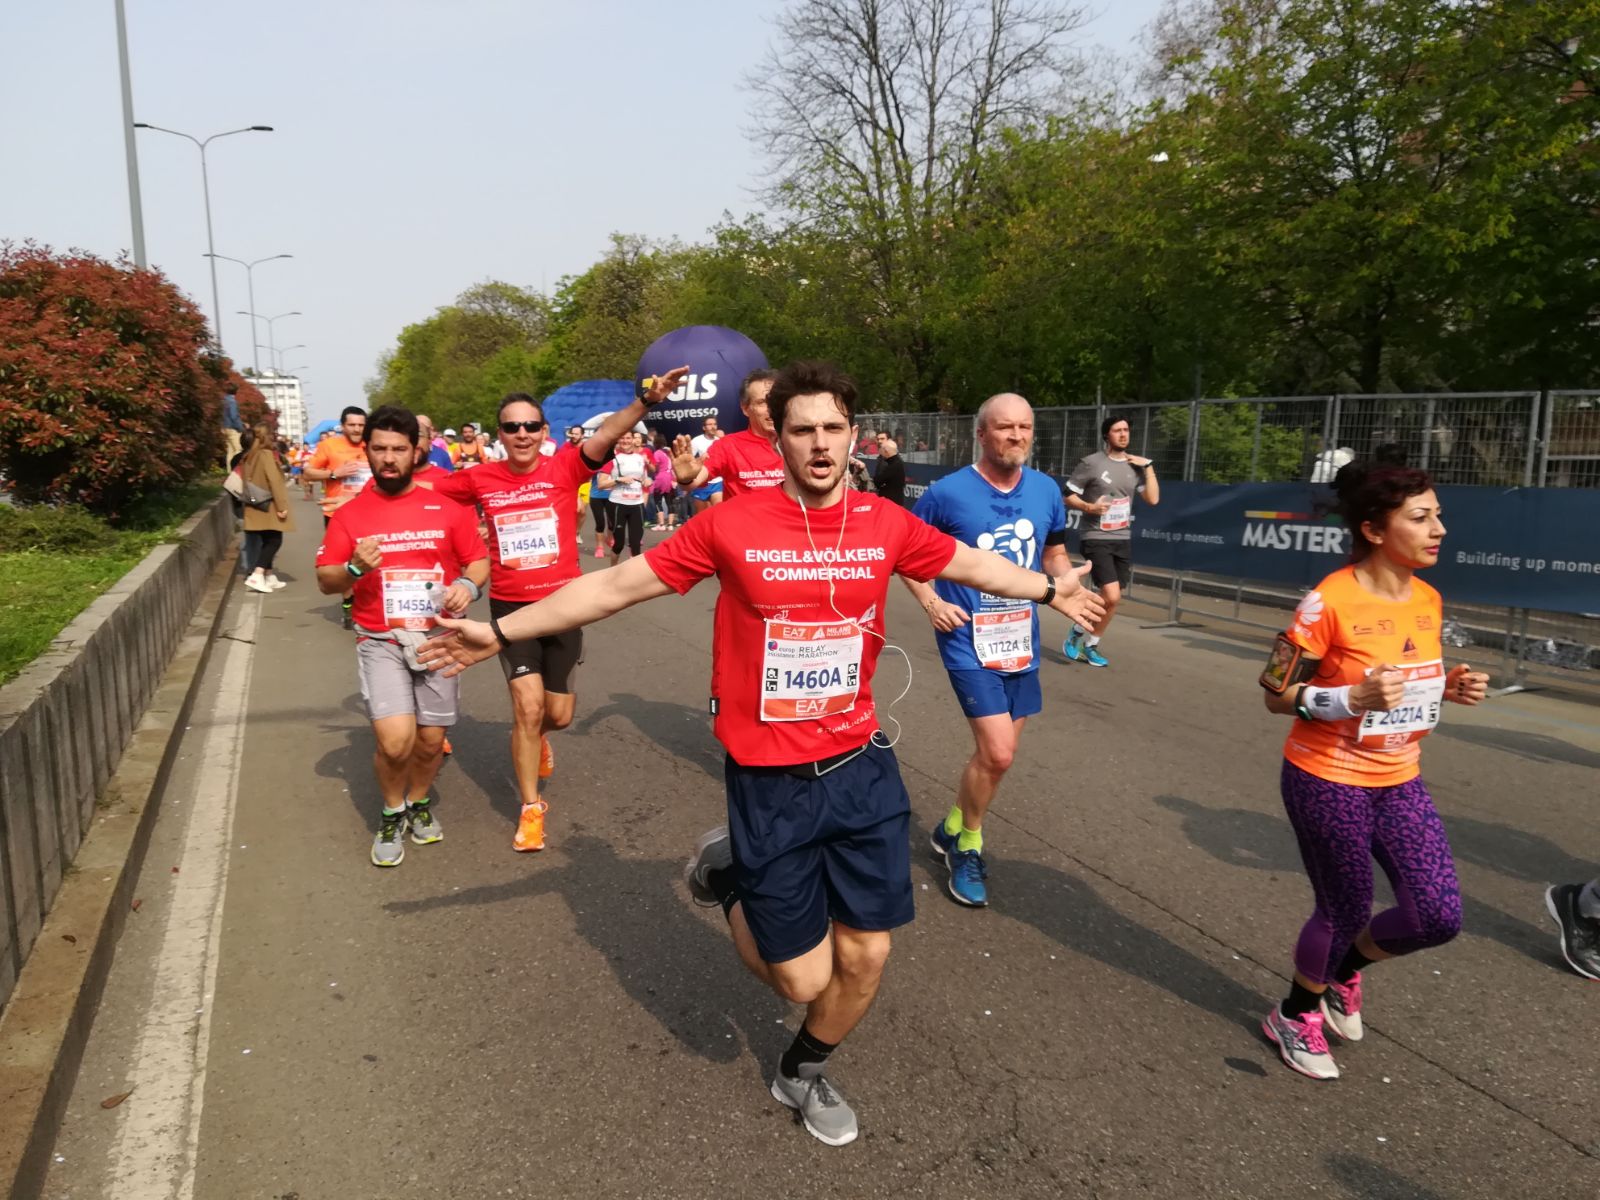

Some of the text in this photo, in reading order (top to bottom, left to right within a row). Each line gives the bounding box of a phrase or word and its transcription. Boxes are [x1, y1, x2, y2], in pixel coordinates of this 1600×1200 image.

[666, 373, 718, 402] GLS
[664, 407, 719, 422] espresso
[1141, 529, 1171, 542] Building
[1173, 533, 1182, 542] up
[1241, 522, 1350, 554] MASTER
[378, 541, 438, 553] OMMERCIAL
[511, 537, 546, 552] 1454A
[744, 547, 886, 563] ENGEL&VÖLKERS
[1456, 551, 1521, 570] Building
[1526, 559, 1546, 572] up
[762, 566, 875, 582] COMMERCIAL
[398, 599, 434, 611] 1455A
[783, 626, 807, 636] EA7
[798, 650, 838, 659] MARATHON
[799, 645, 826, 653] RELAY
[988, 640, 1020, 655] 1722A
[784, 667, 842, 689] 1460A
[796, 698, 829, 713] EA7
[1379, 706, 1423, 725] 2021A
